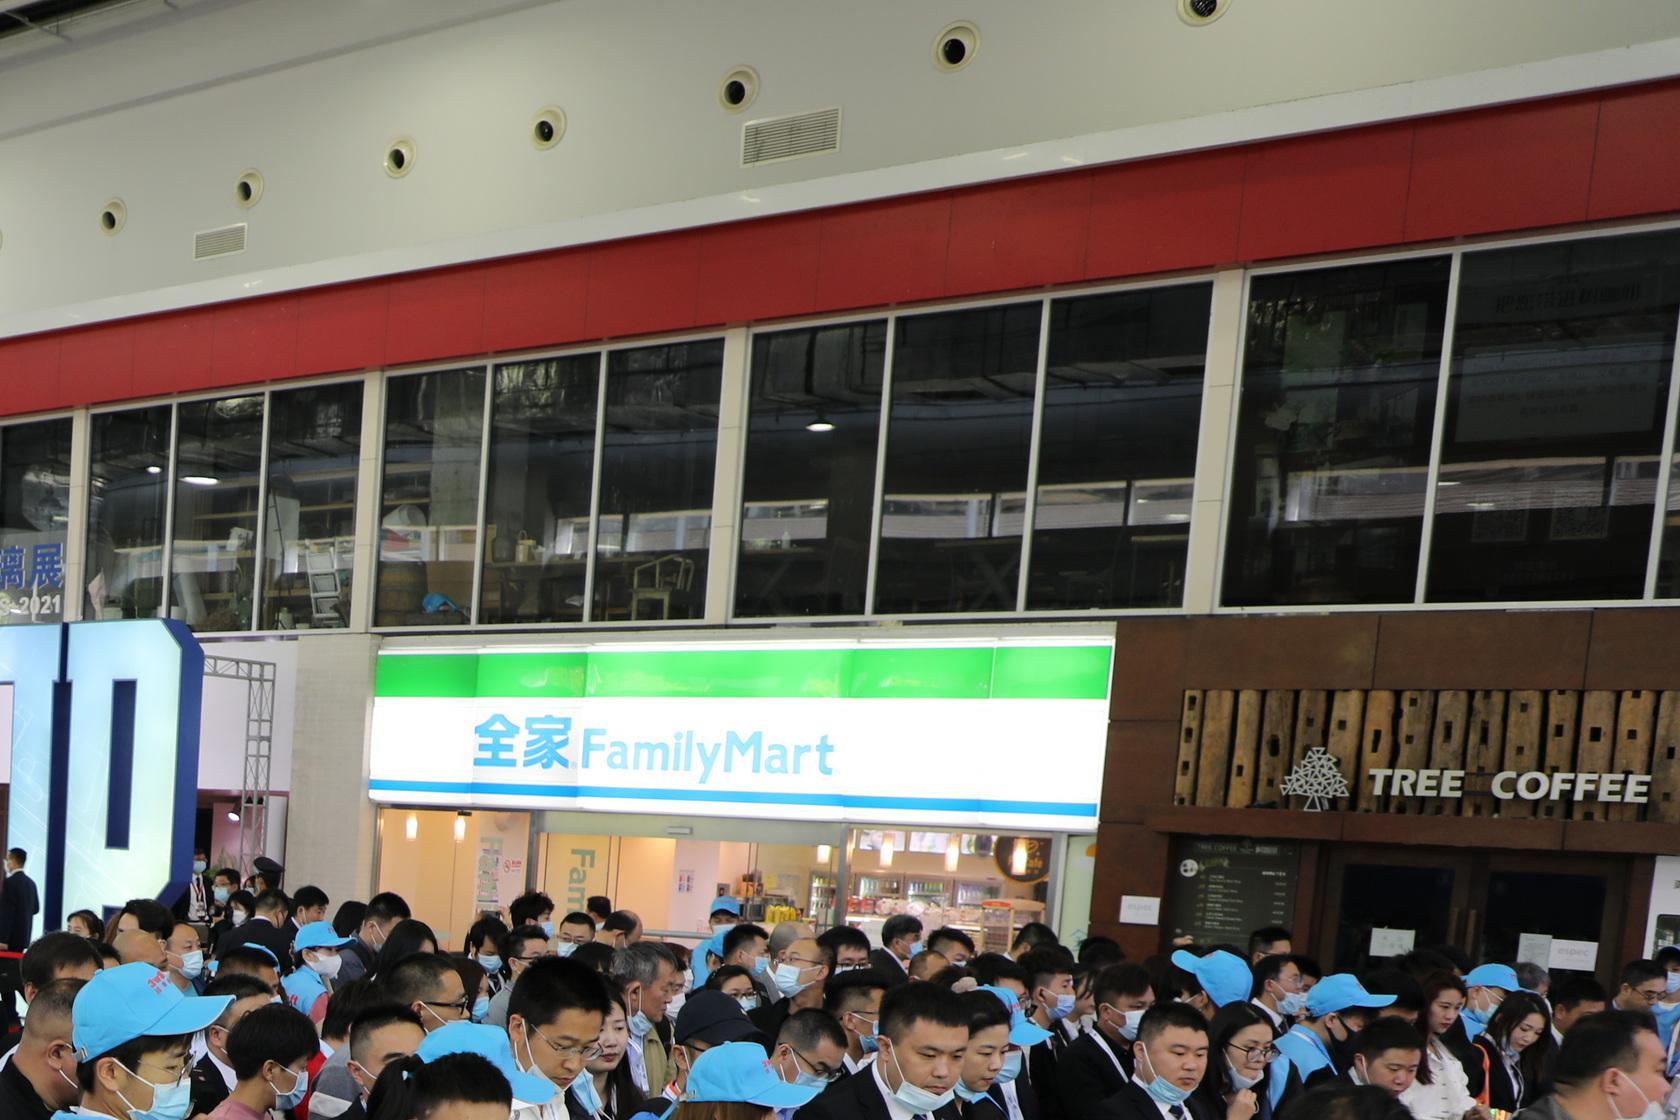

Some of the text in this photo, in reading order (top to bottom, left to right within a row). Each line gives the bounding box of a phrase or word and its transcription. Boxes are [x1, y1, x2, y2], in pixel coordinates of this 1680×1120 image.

[20, 594, 61, 615] 2021
[473, 714, 573, 769] 全家
[581, 728, 835, 784] FamilyMart
[1369, 768, 1653, 804] TREE COFFEE
